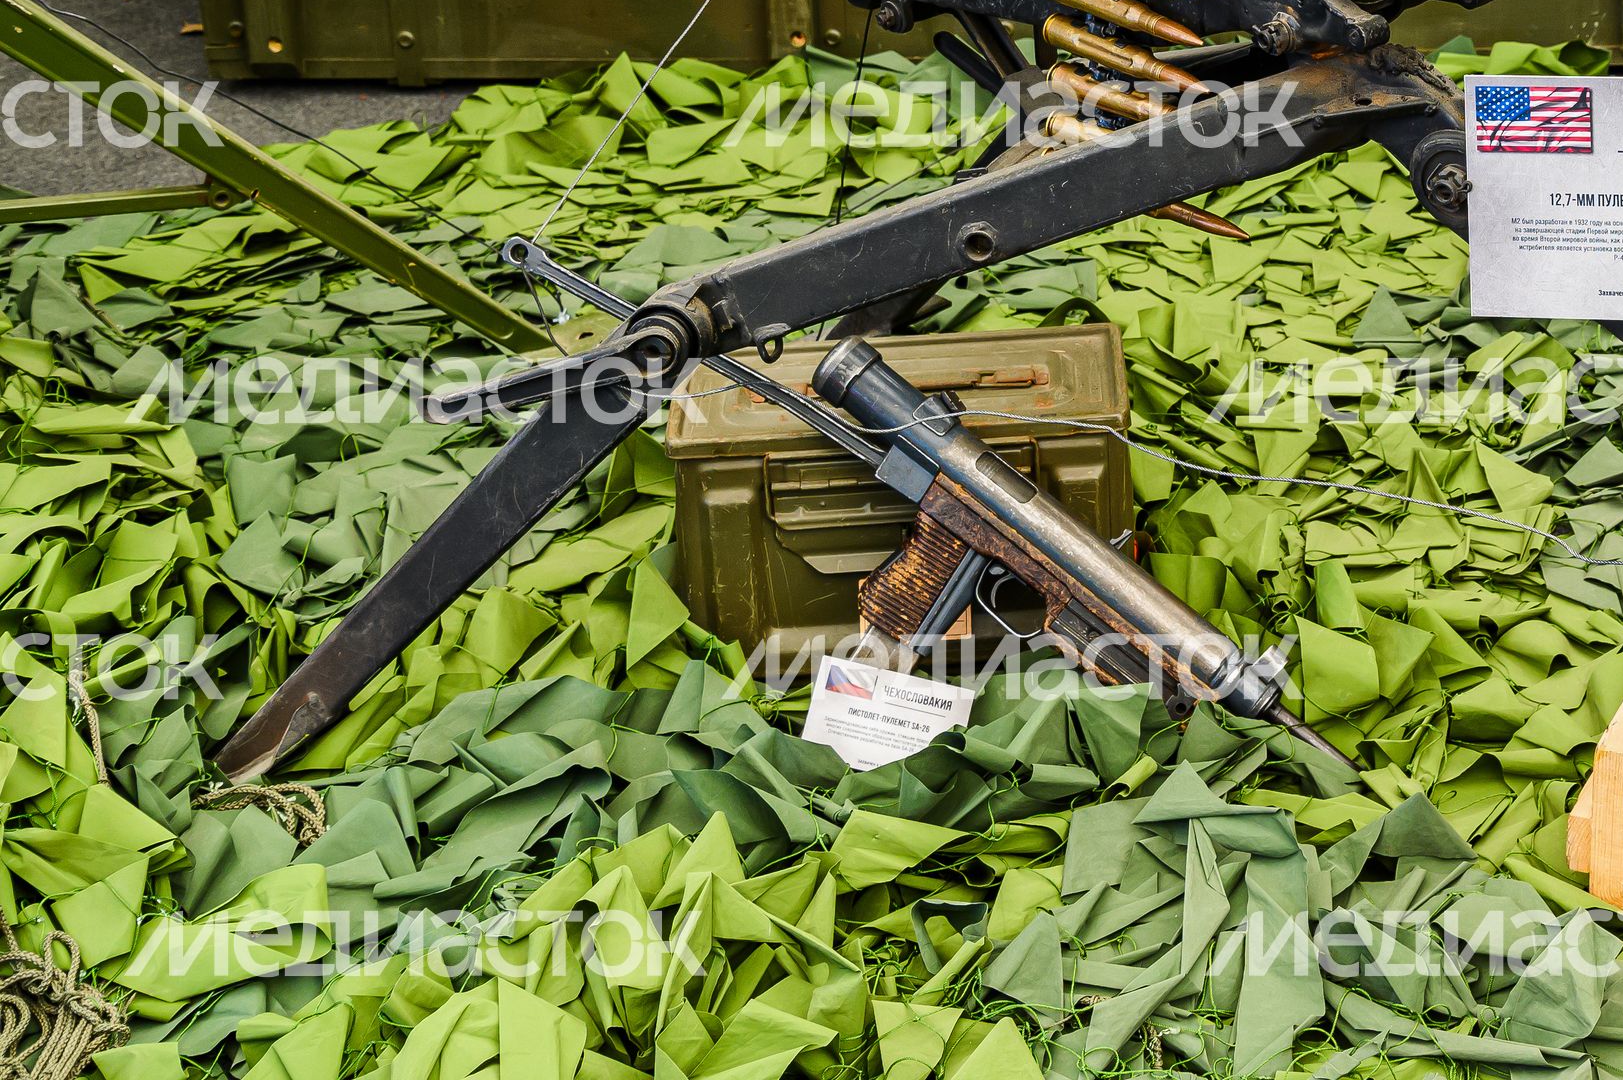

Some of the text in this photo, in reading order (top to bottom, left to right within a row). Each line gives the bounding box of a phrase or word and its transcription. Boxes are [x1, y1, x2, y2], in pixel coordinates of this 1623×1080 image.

[1549, 193, 1595, 207] 12,7-ММ
[884, 685, 953, 711] ЧЕХОСЛОВАКИЯ
[848, 707, 911, 729] ПИСТОЛЕТ-ПУЛЕМЕТ
[911, 721, 931, 733] SA-26
